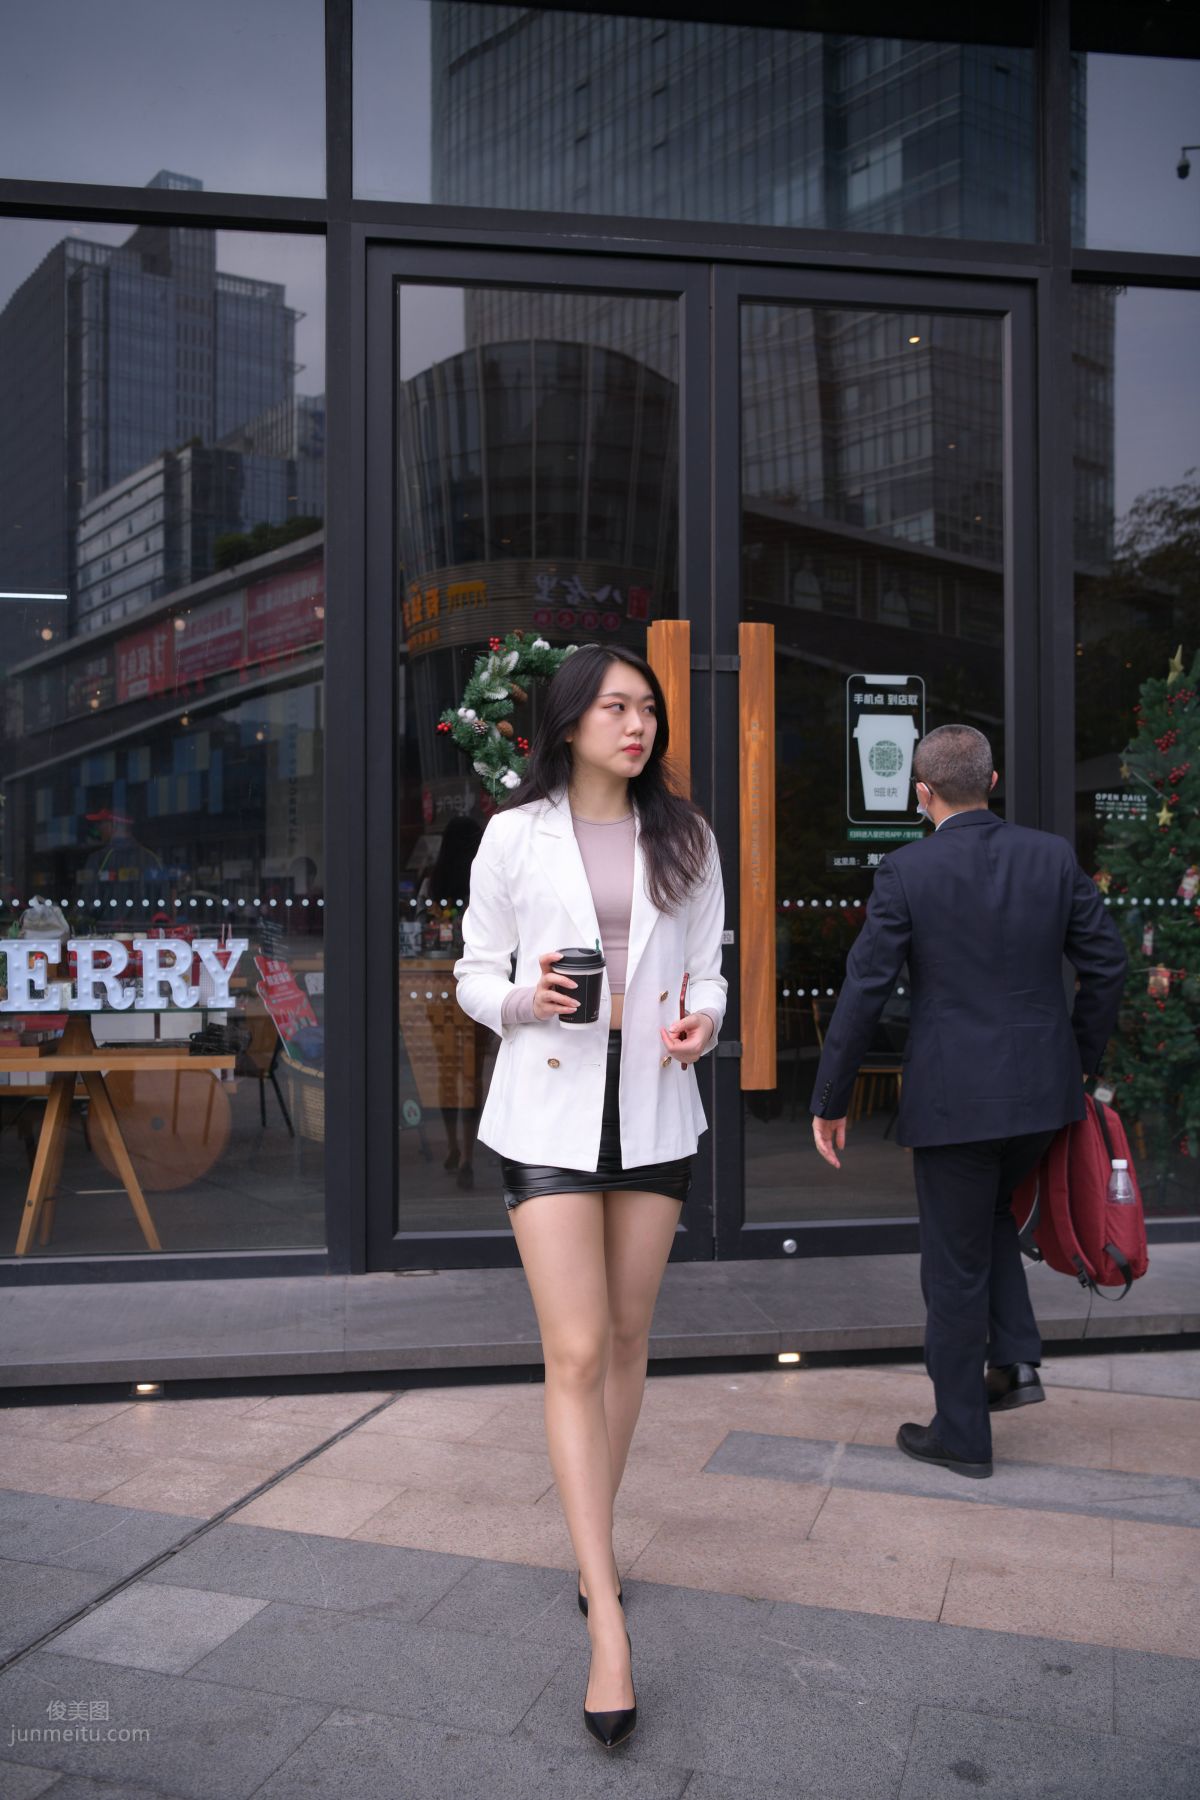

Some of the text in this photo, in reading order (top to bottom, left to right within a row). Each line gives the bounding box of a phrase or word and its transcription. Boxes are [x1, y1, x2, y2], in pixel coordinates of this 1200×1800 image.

[853, 693, 919, 706] 手机点 到店取
[1095, 793, 1147, 802] OPEN DAILY
[0, 938, 249, 1012] ERRY
